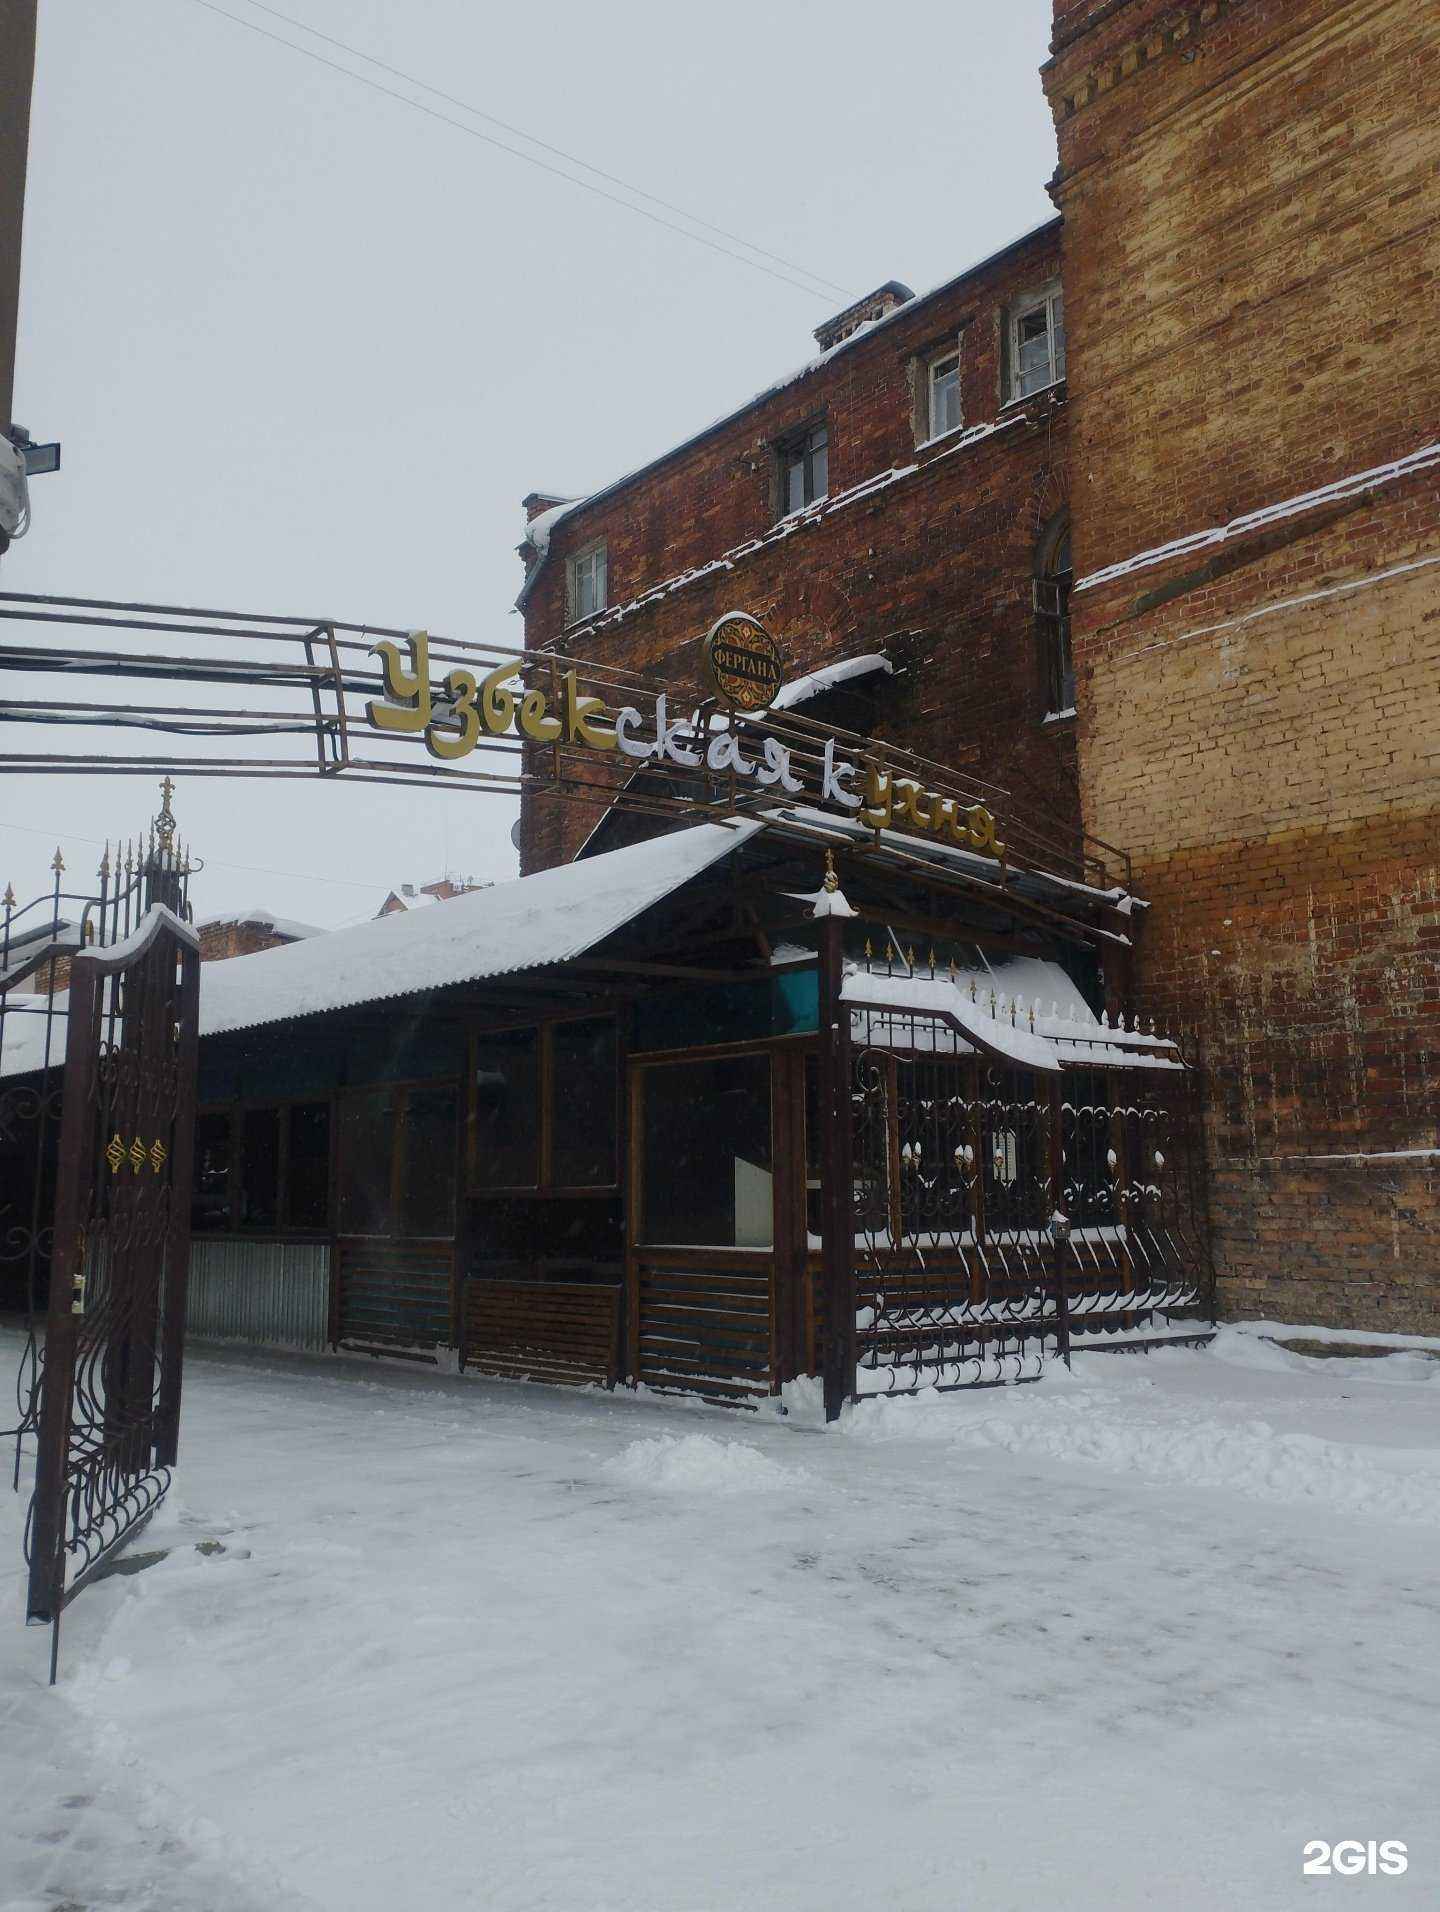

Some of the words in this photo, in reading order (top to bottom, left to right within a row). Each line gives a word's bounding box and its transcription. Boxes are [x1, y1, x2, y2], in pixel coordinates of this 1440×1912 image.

[714, 649, 777, 680] ФЕРГАНА
[365, 630, 805, 792] Узбекская
[822, 737, 1007, 856] кухня
